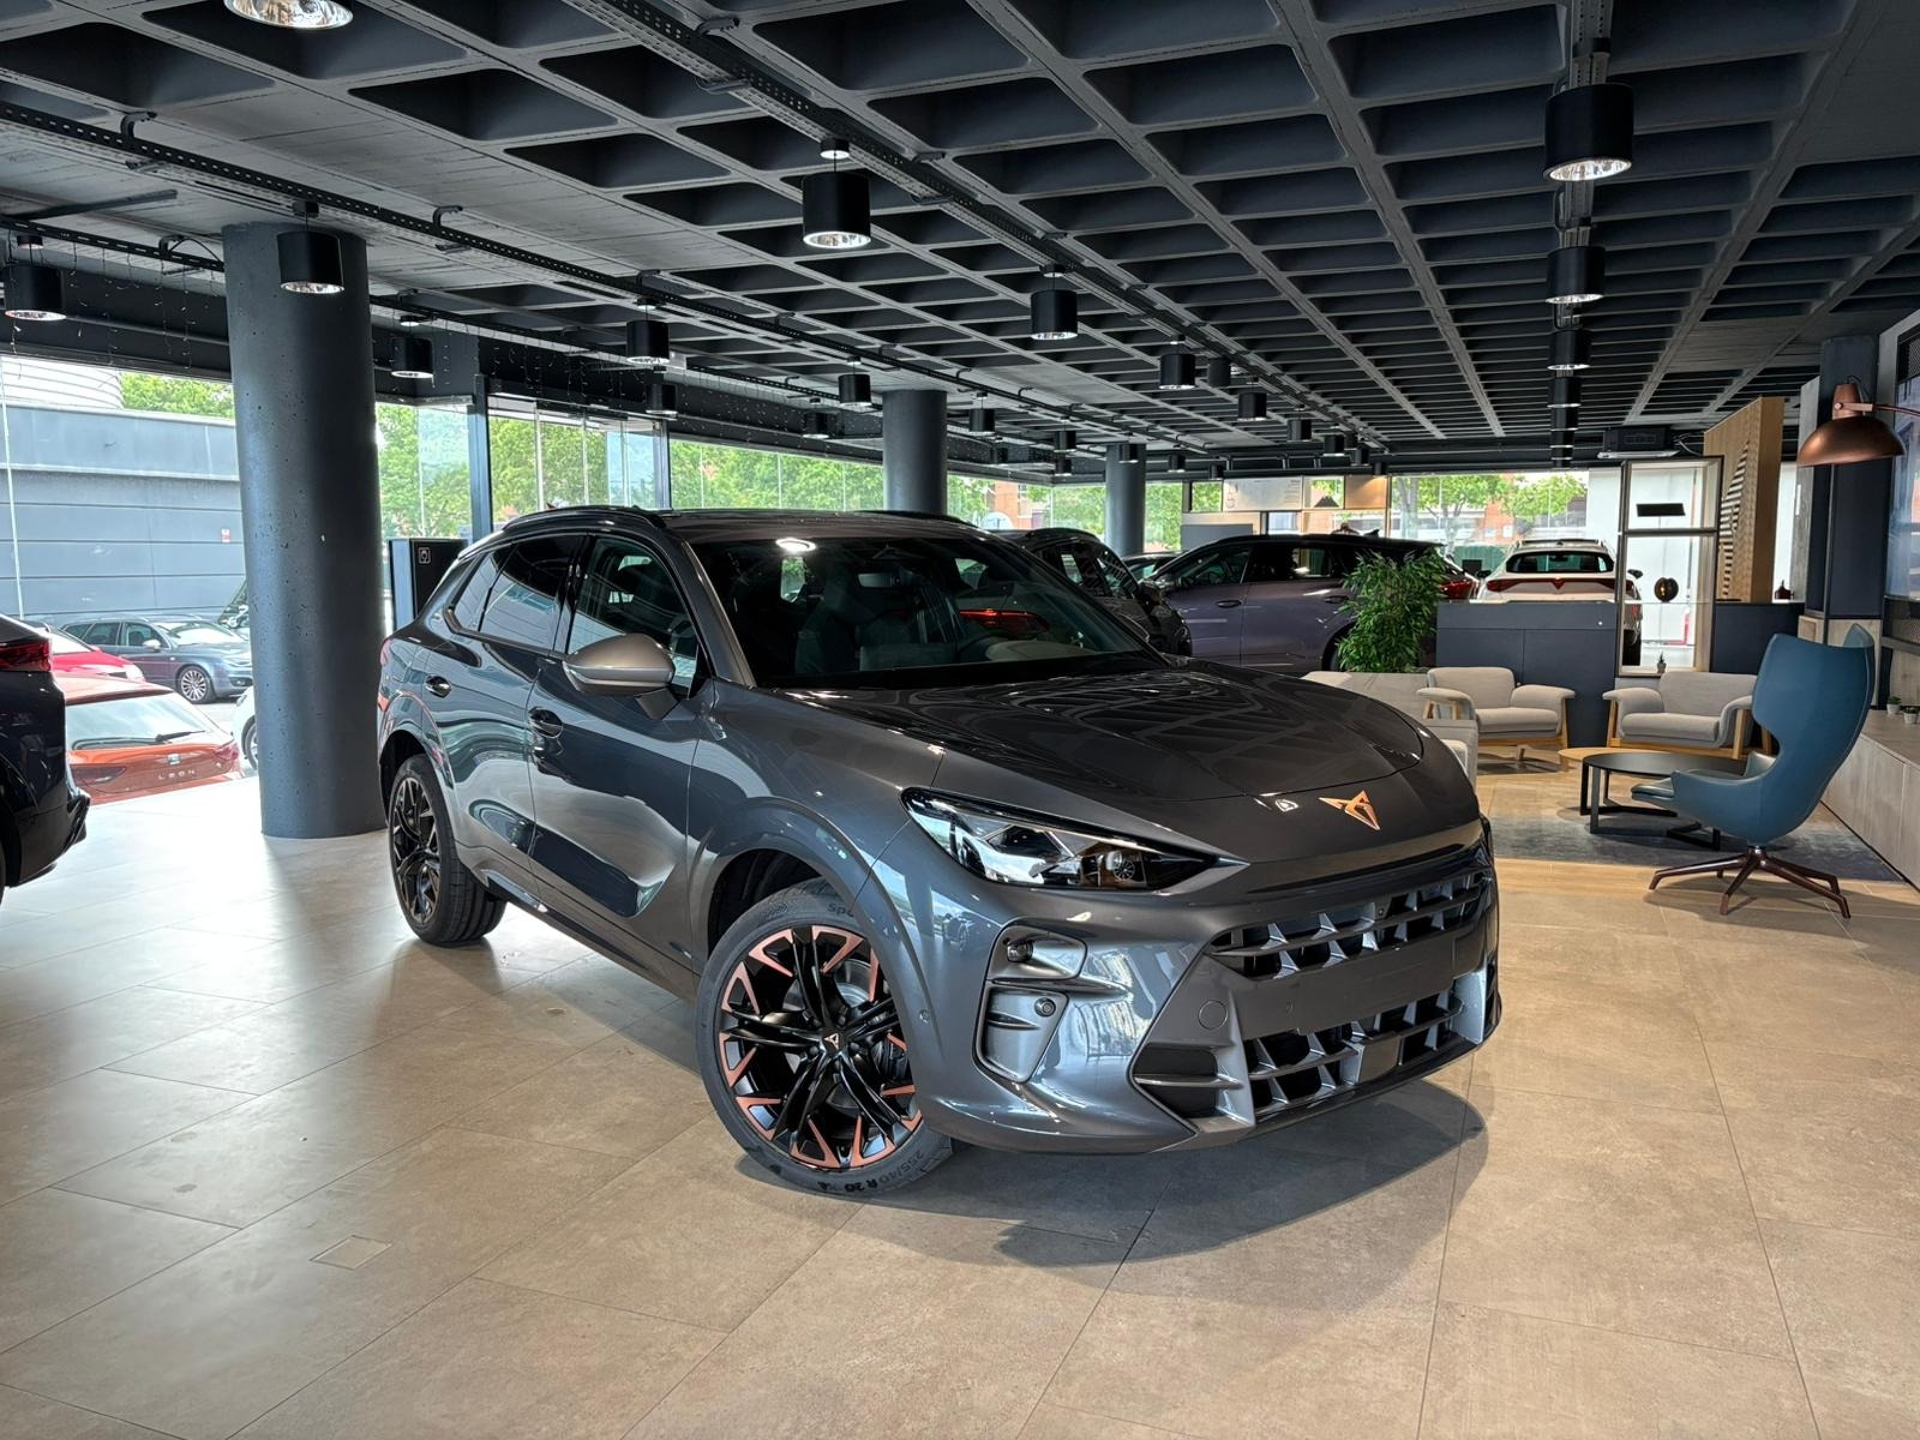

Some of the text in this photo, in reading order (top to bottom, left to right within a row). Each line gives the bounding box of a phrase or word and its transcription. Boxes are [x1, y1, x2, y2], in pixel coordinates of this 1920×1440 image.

[879, 1150, 924, 1184] 255/40
[844, 1181, 865, 1193] 20
[866, 1178, 878, 1189] R
